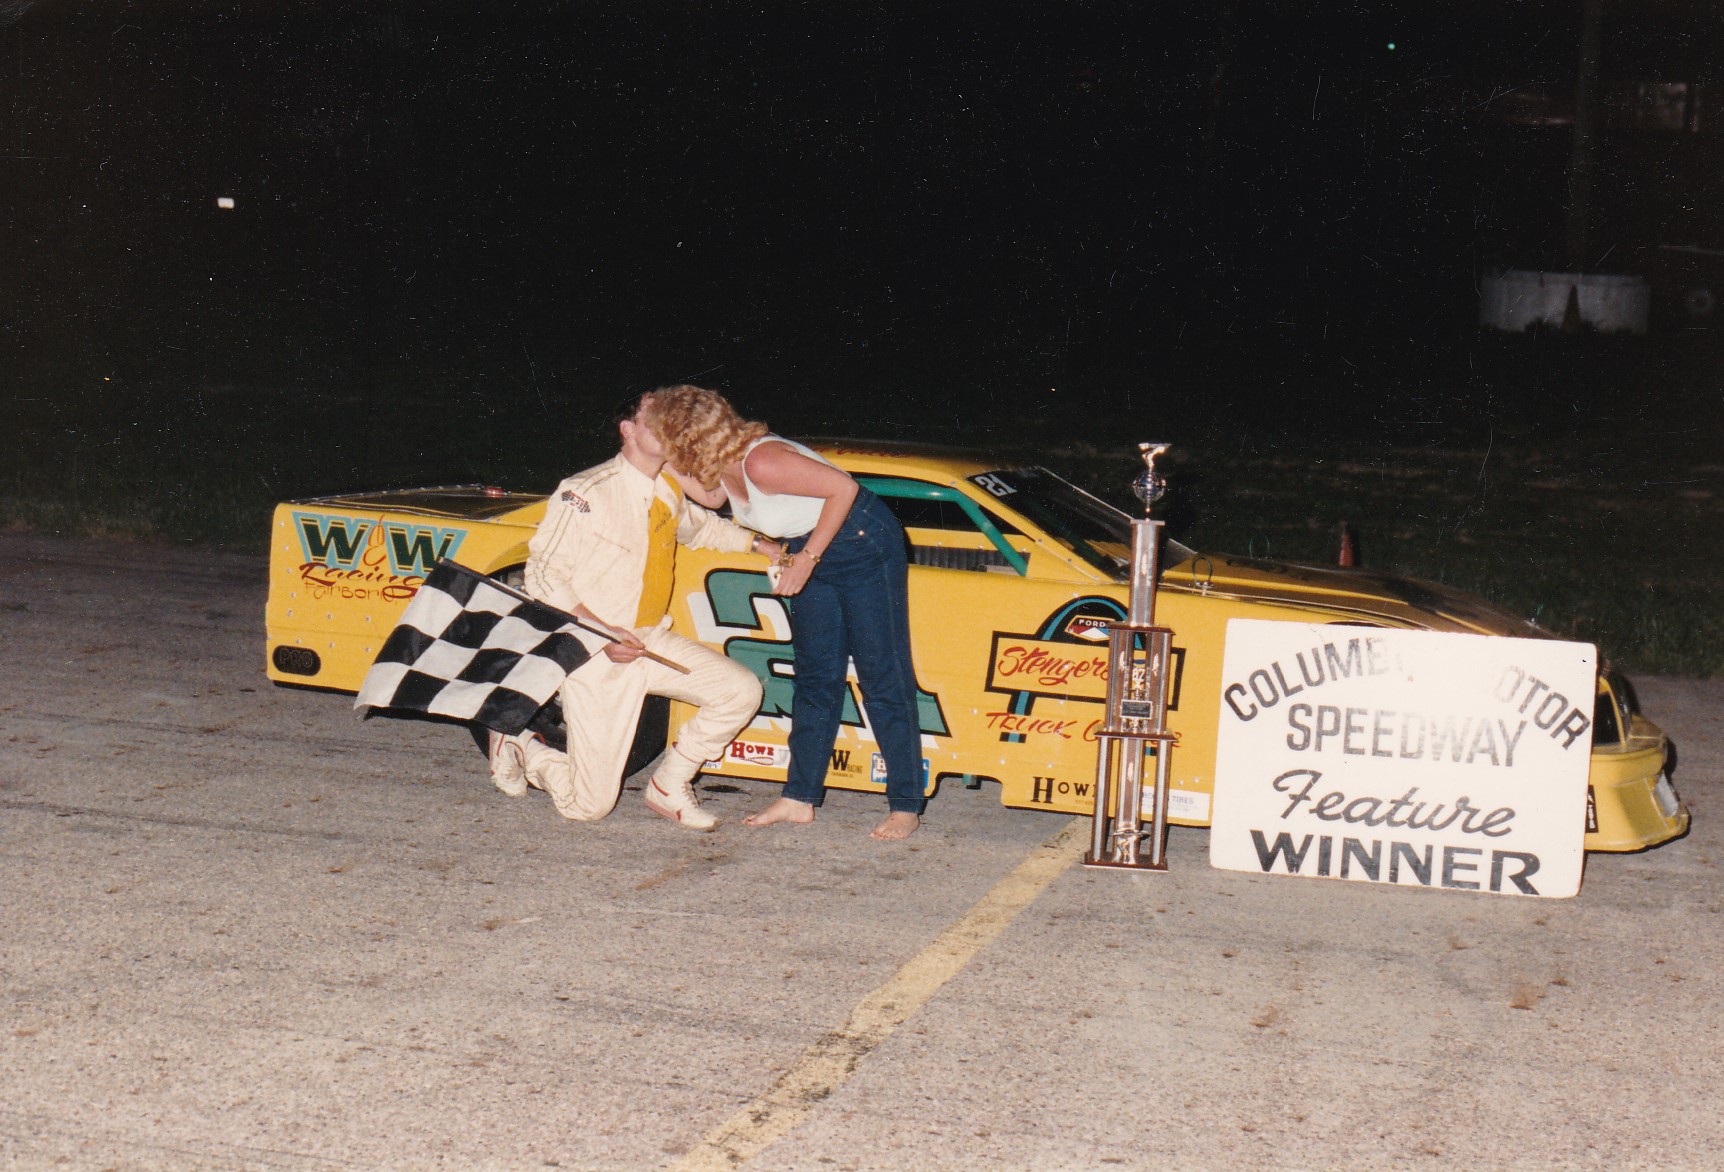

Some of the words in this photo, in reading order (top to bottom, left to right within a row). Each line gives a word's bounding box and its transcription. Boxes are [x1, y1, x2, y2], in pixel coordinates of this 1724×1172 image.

[1078, 618, 1107, 628] FORD
[985, 712, 1078, 739] TRUCK
[1493, 664, 1592, 751] OTOR
[1286, 702, 1528, 767] SPEEDWAY
[1030, 776, 1096, 804] HOW
[1172, 795, 1194, 805] TIRES
[1272, 769, 1516, 837] Feature
[1250, 829, 1541, 895] WINNER
